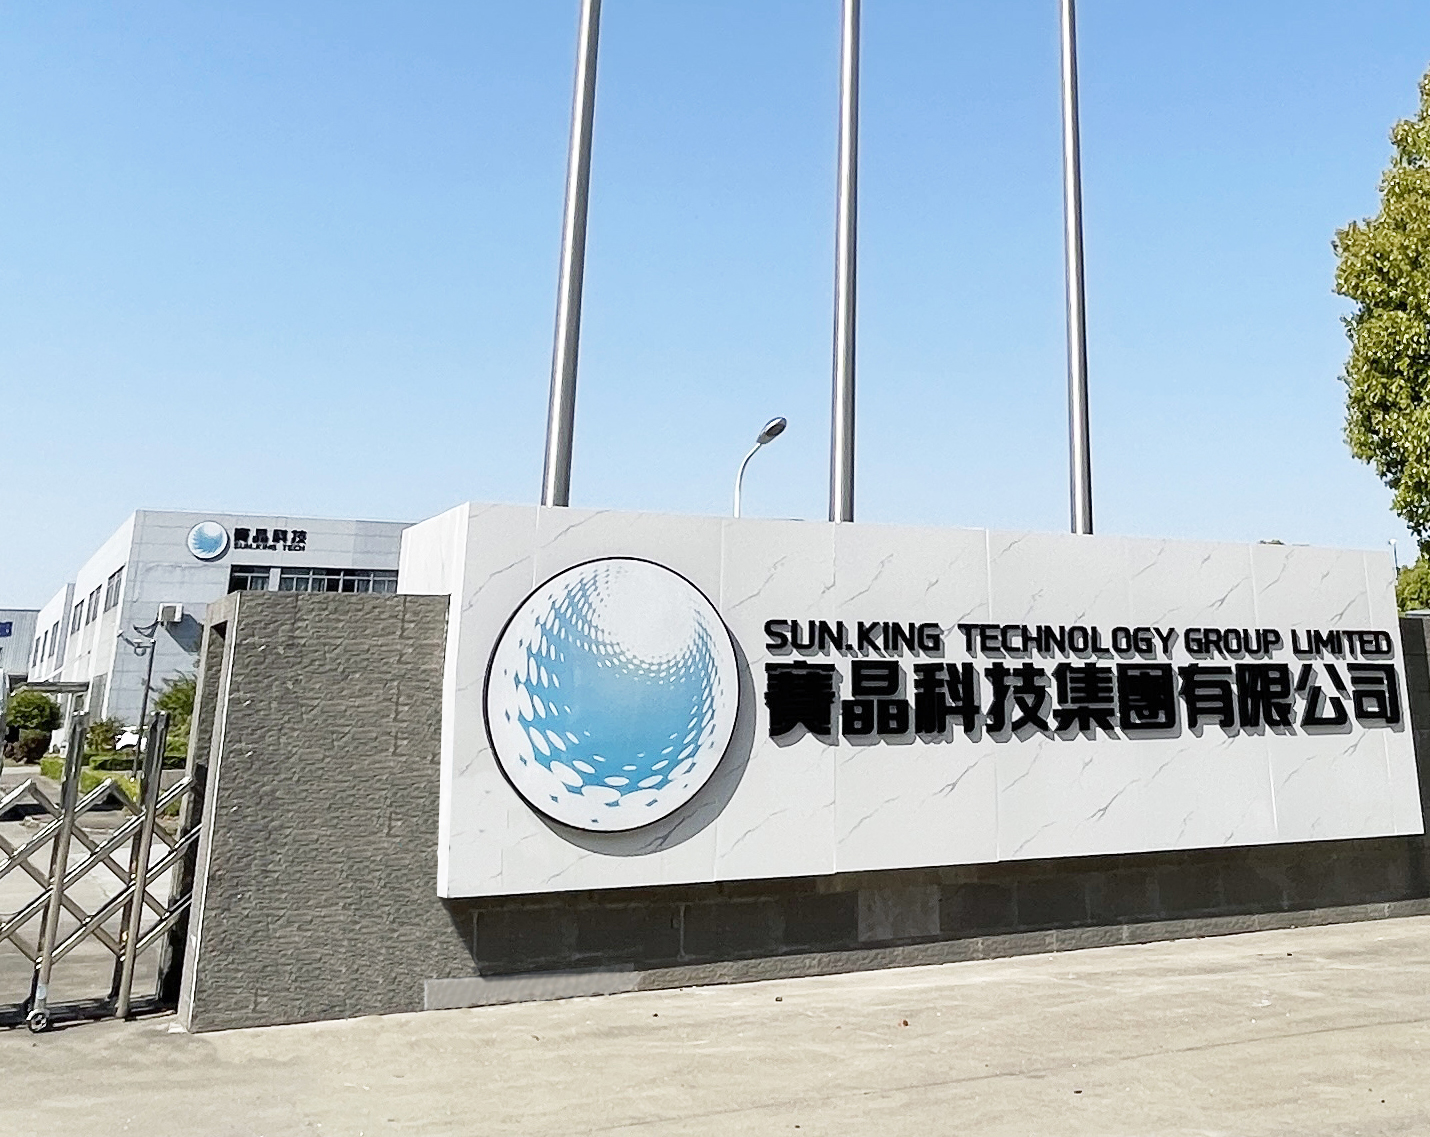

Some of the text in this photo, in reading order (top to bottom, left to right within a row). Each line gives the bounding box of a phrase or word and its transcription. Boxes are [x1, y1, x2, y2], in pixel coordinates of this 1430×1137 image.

[957, 623, 1176, 656] TECHNOLOGY
[1184, 627, 1281, 656] GROUP
[1291, 628, 1393, 656] LIMITED
